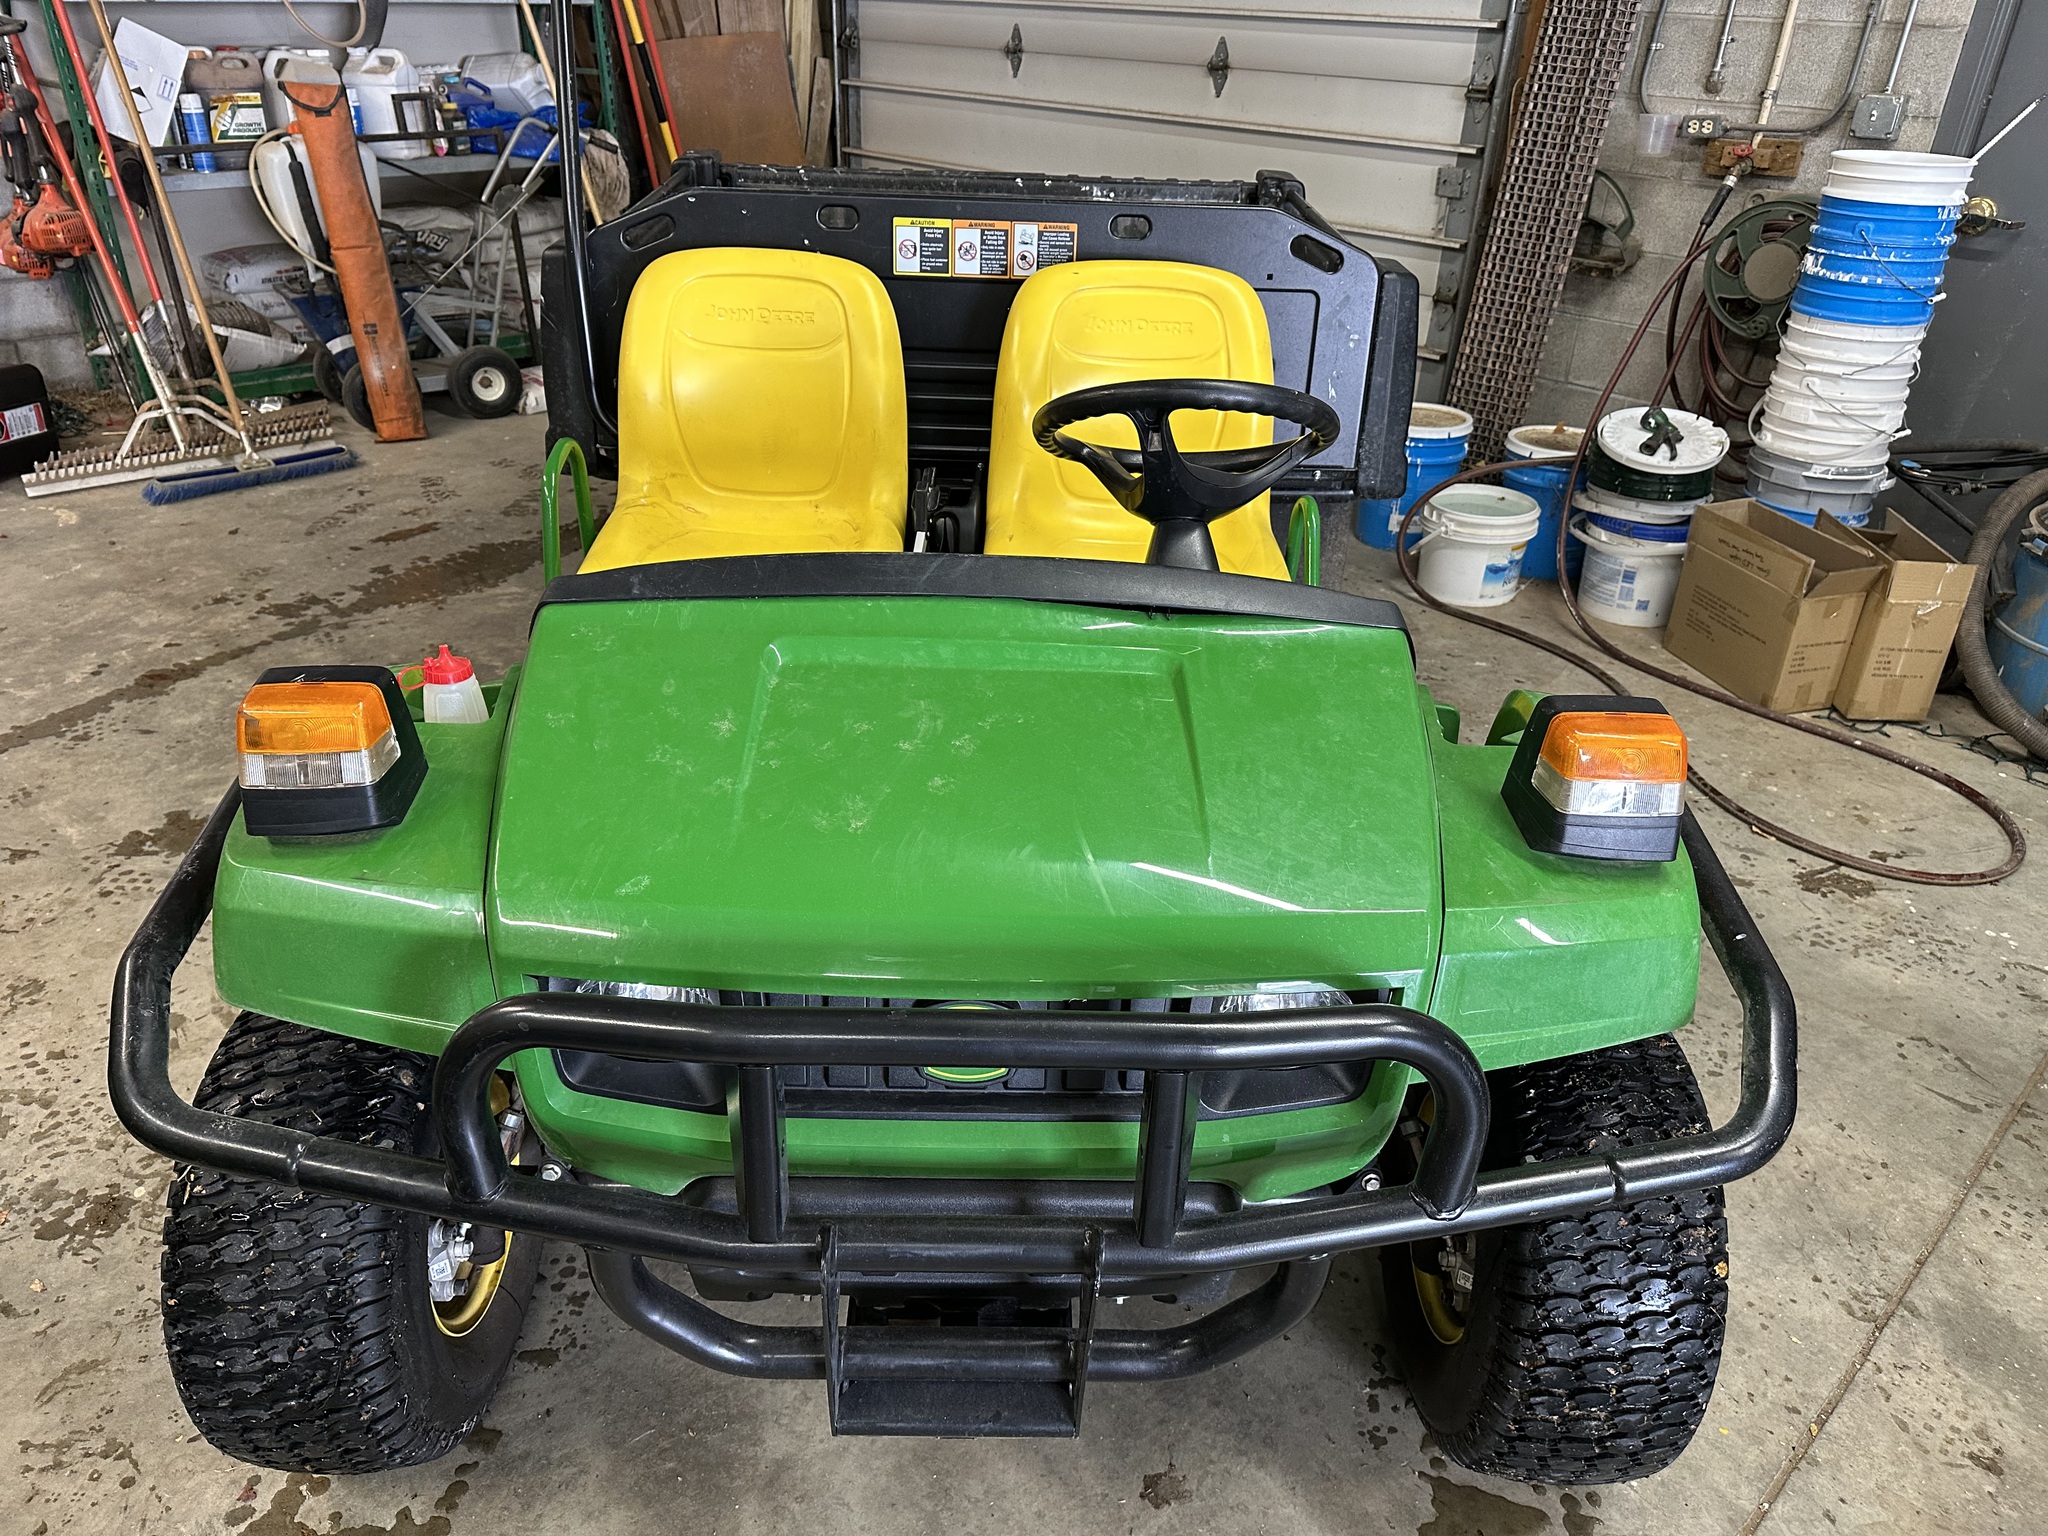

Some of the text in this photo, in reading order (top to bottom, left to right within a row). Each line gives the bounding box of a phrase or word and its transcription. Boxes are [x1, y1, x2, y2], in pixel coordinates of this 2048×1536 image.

[705, 304, 815, 324] JOHN DEERE
[1084, 316, 1193, 334] JOHN DEERE
